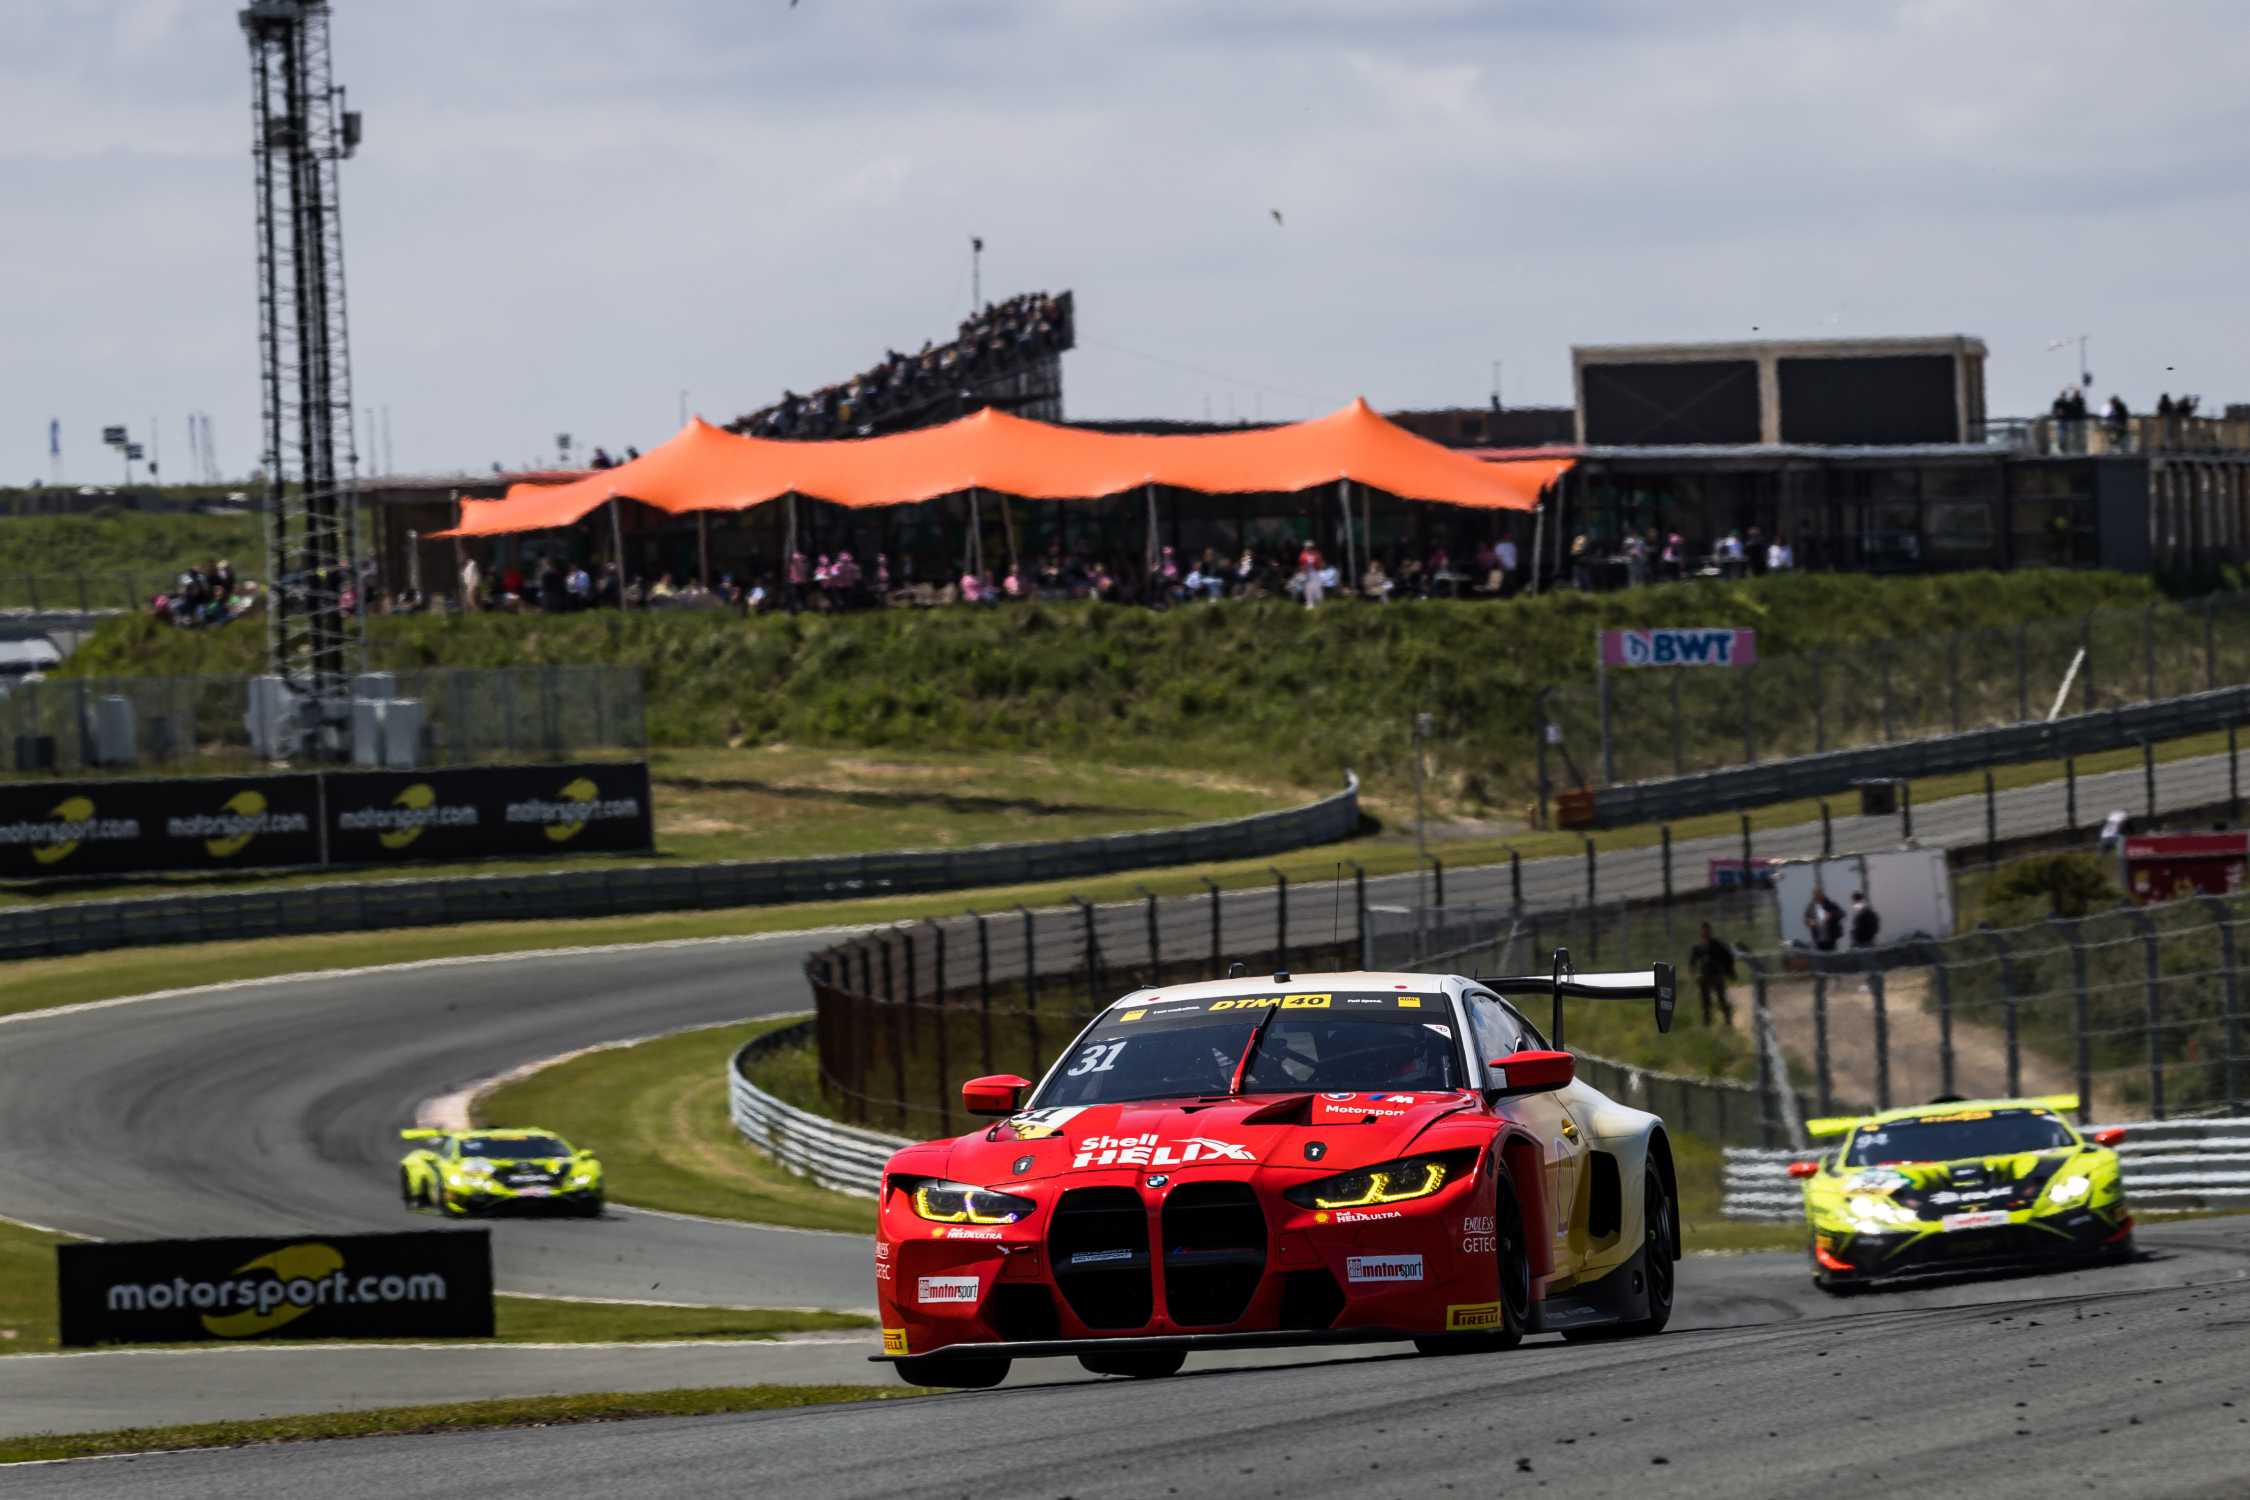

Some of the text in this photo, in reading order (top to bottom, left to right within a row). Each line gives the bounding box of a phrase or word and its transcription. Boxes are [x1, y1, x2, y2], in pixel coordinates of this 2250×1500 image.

[1655, 633, 1732, 661] BWT
[339, 804, 479, 832] motorsport.com
[505, 797, 639, 825] motorsport.com
[167, 812, 306, 840] motorsport.com
[1208, 997, 1282, 1011] DTM
[1289, 996, 1325, 1006] 40
[1067, 1041, 1128, 1077] 31
[1325, 1104, 1406, 1117] Motorsport
[1073, 1138, 1257, 1168] HELIX
[1080, 1133, 1160, 1151] Shell
[1463, 1216, 1495, 1231] ENDLESS
[1462, 1237, 1497, 1253] GETEC
[1362, 1261, 1422, 1279] motorsport
[108, 1271, 446, 1316] motorsport.com
[929, 1283, 977, 1300] motorsport
